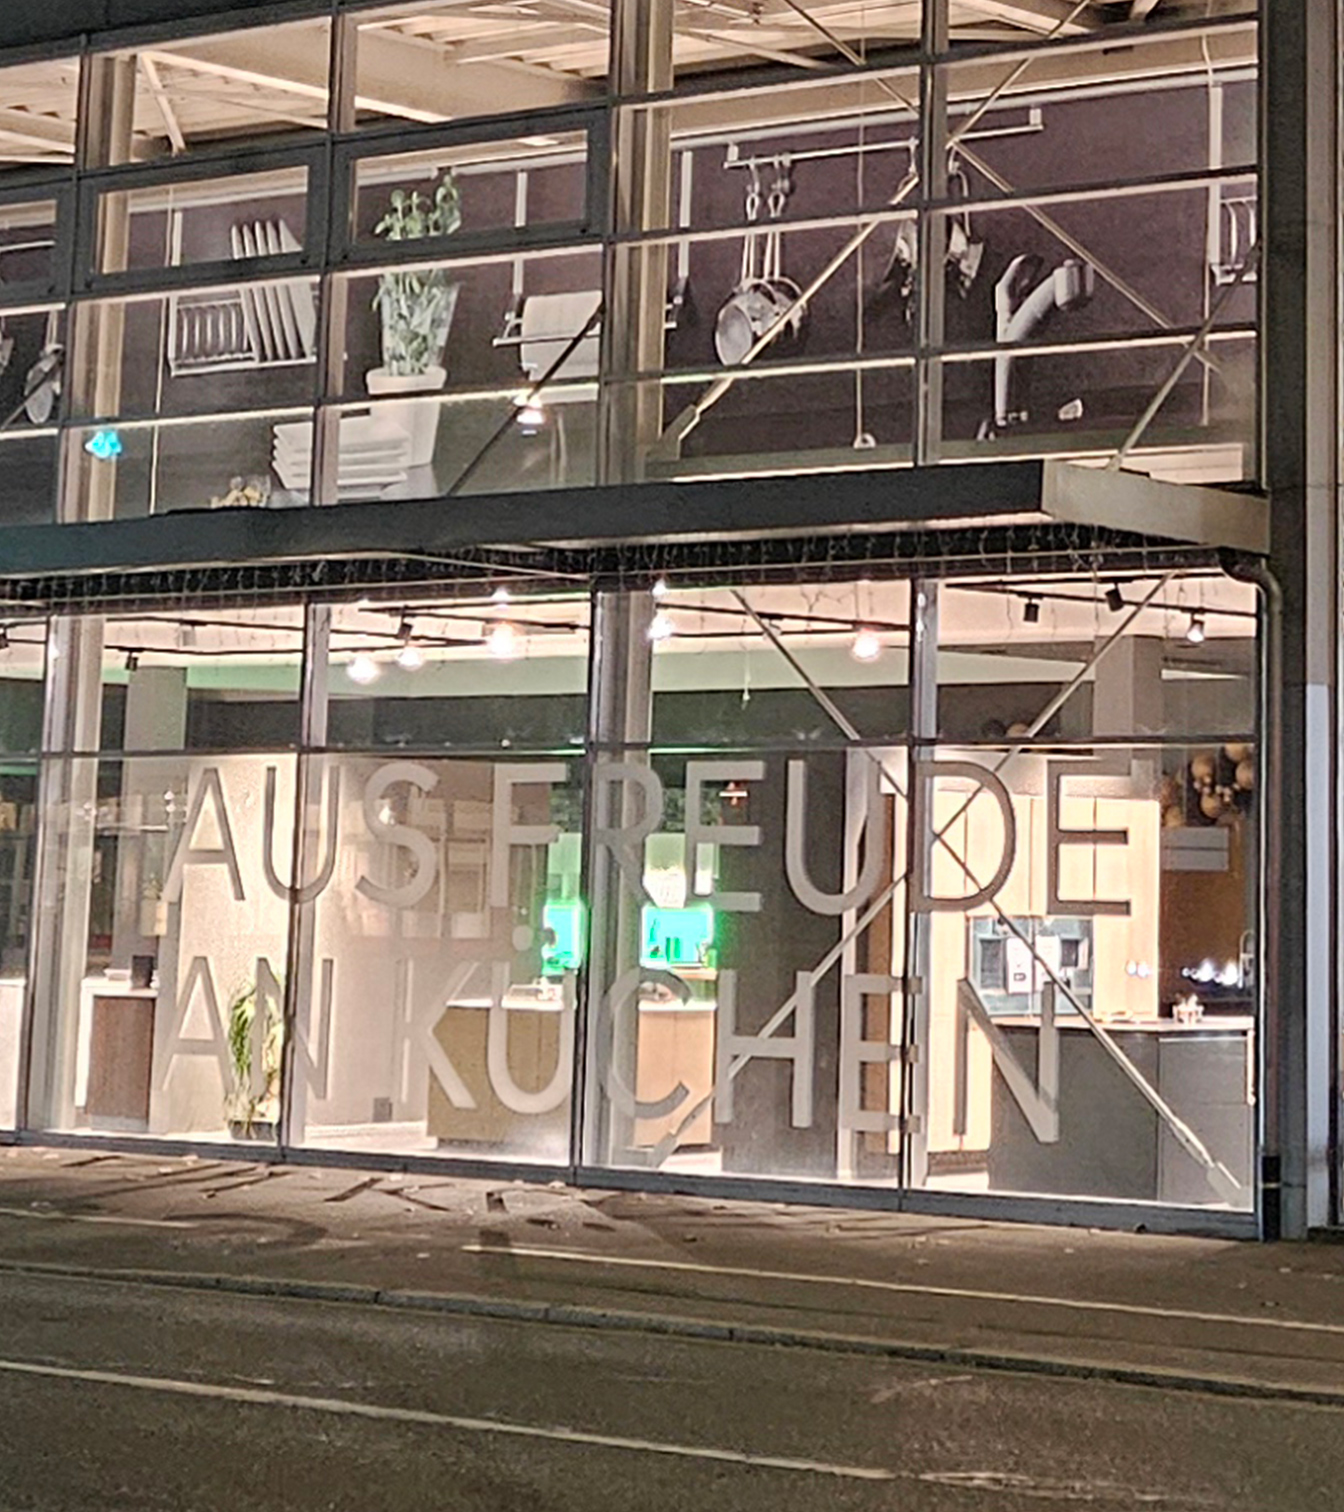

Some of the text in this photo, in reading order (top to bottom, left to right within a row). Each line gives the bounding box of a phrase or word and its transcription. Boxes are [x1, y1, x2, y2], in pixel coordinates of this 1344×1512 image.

[163, 758, 1132, 917] AUS FREUDE
[161, 923, 1060, 1144] AN KÜCHEN
